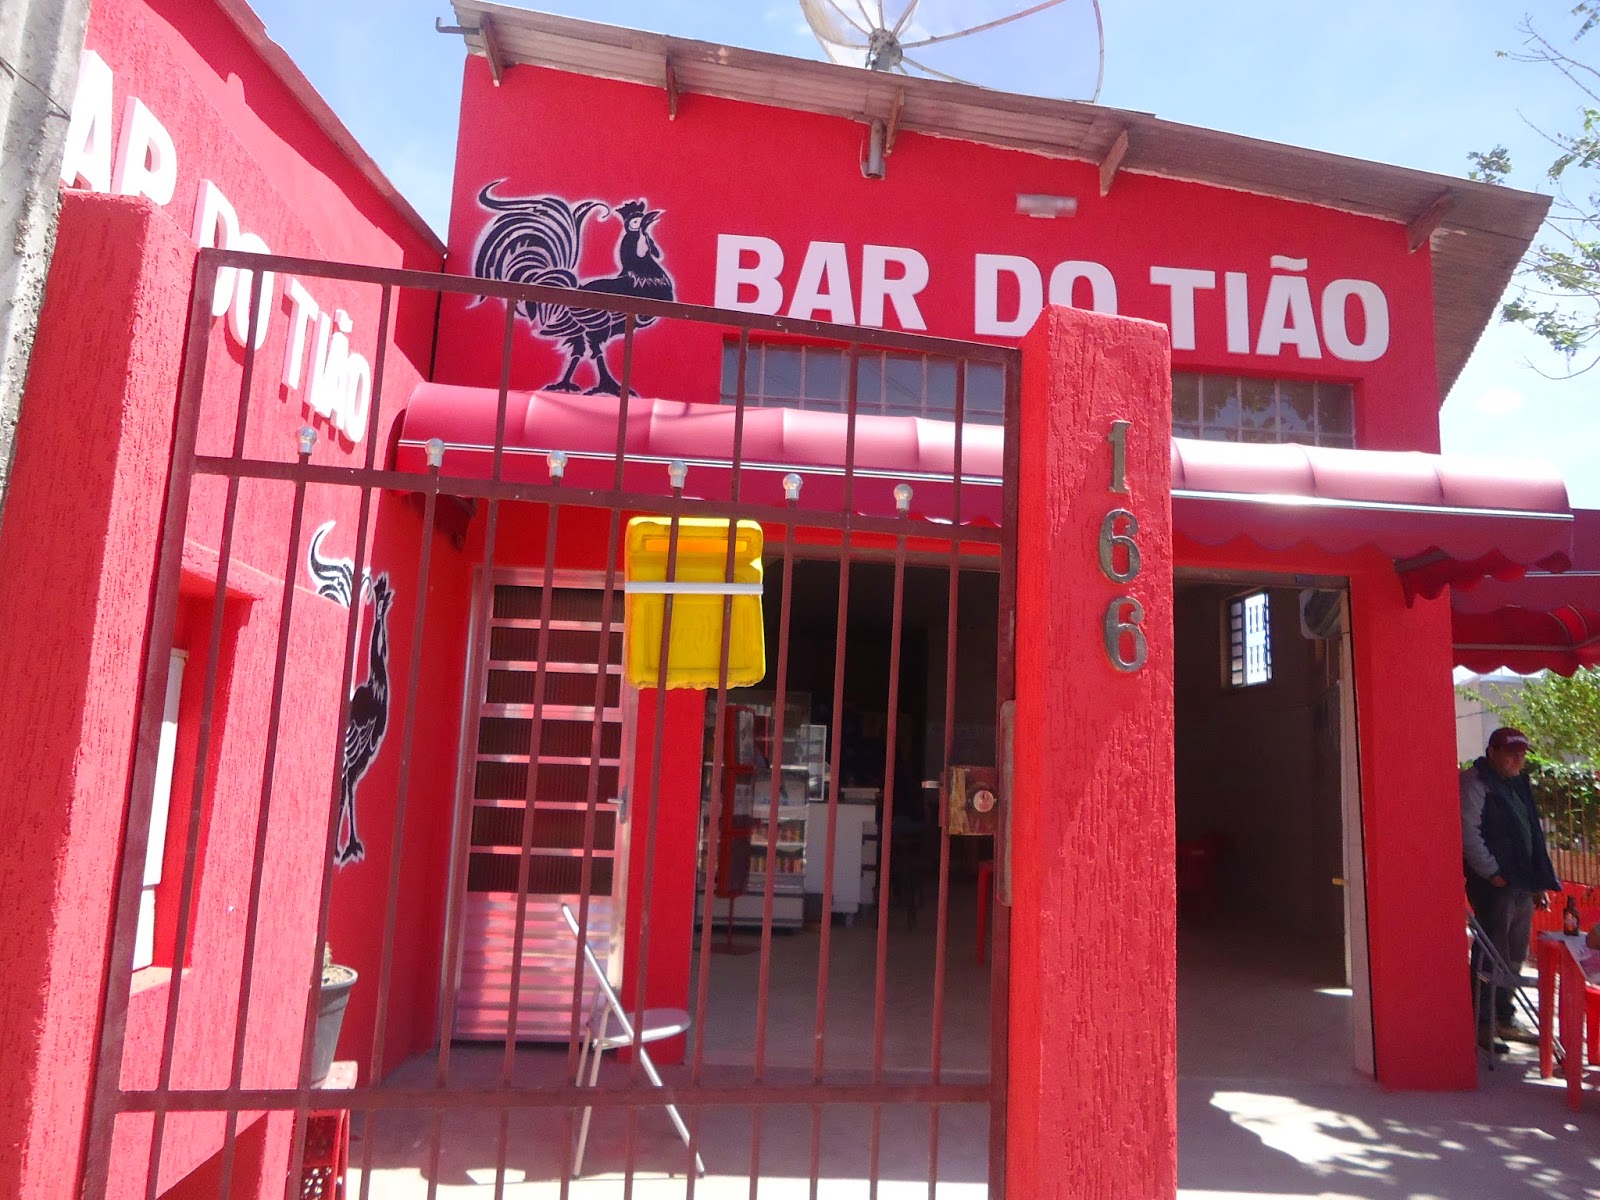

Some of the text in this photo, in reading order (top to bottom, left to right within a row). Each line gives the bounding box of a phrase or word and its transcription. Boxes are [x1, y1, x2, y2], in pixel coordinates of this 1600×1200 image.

[191, 179, 275, 350] DO
[281, 277, 372, 443] TIÃO
[714, 233, 1391, 362] BAR DO TIÃO
[1098, 420, 1148, 673] 166
